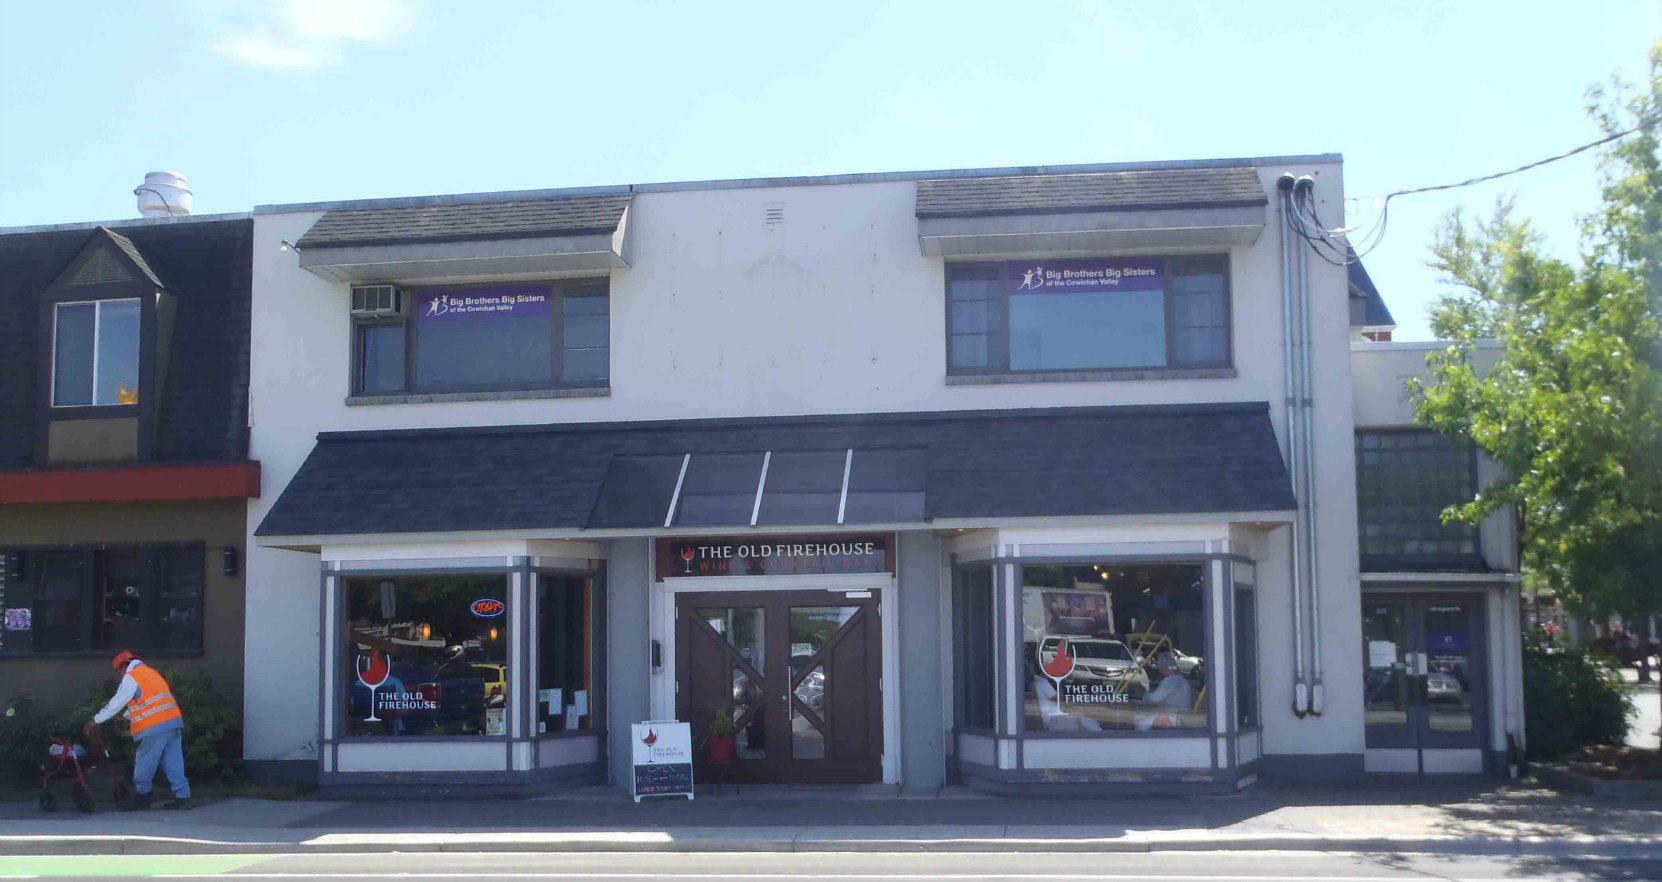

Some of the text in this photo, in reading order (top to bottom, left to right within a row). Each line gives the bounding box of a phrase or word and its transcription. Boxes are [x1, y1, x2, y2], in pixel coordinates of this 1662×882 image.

[1046, 267, 1156, 280] Big Brothers Big Sisters
[1054, 279, 1065, 287] the
[1066, 278, 1099, 287] Cowichan
[1100, 278, 1119, 286] Valley
[450, 294, 545, 307] Big Brothers Big Sisters
[496, 304, 513, 312] Valley
[698, 542, 875, 559] THE OLD FIREHOUSE
[1065, 685, 1114, 693] THE OLD
[379, 691, 423, 700] THE OLD
[1065, 694, 1129, 703] FIREHOUSE
[379, 701, 437, 709] FIREHOUSE
